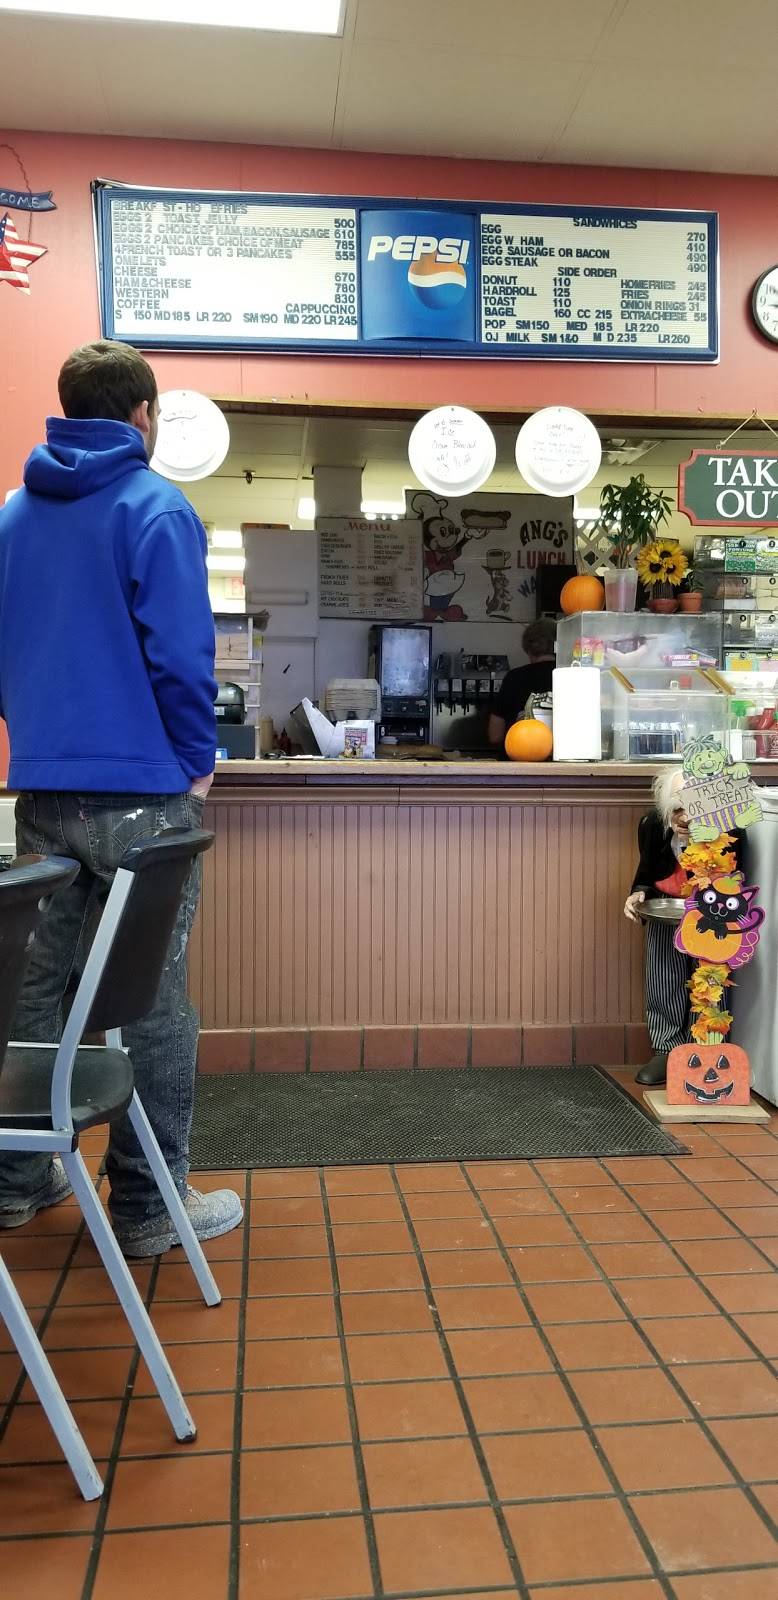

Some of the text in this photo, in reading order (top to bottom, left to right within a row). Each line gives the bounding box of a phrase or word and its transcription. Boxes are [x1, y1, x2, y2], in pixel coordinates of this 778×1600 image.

[113, 212, 142, 222] EGGS
[144, 213, 152, 222] 2
[204, 214, 238, 225] JELLY
[334, 218, 354, 228] 500
[113, 223, 143, 233] EGGS
[144, 224, 152, 233] 2
[482, 224, 502, 234] EGG
[334, 230, 354, 239] 610
[687, 232, 706, 242] 270
[113, 234, 142, 244] EGGS
[144, 235, 151, 244] 2
[154, 236, 214, 246] PANCAKES
[217, 237, 258, 248] CHOICE
[335, 240, 354, 250] 785
[482, 235, 544, 246] EGG W HAM
[167, 246, 202, 256] TOAST
[207, 247, 222, 257] OR
[226, 248, 234, 258] 3
[237, 248, 292, 259] PANCAKES
[368, 236, 470, 264] PEPSI
[482, 246, 610, 258] EGG SAUSAGE OR BACON
[686, 242, 705, 252] 410
[335, 251, 356, 260] 555
[686, 253, 706, 262] 490
[482, 256, 538, 267] EGG STEAK
[114, 266, 158, 276] CHEESE
[558, 267, 618, 278] SIDE ORDER
[687, 264, 706, 272] 490
[334, 272, 355, 282] 670
[483, 276, 571, 287] DONUT 110
[335, 283, 355, 293] 780
[620, 280, 706, 291] HOMEFRIES 245
[116, 288, 169, 298] WESTERN
[553, 288, 570, 298] 125
[622, 290, 706, 302] FRIES 245
[117, 298, 160, 310] COFFEE
[334, 294, 355, 304] 830
[483, 296, 571, 308] TOAST 110
[286, 304, 356, 314] CAPPUCCINO
[620, 300, 700, 312] ONION RINGS 31
[116, 310, 122, 320] S
[134, 311, 152, 320] 150
[212, 312, 232, 322] 220
[484, 307, 612, 320] BAGEL 160 CC 215
[484, 320, 506, 329] POP
[566, 321, 588, 331] MED
[594, 322, 612, 332] 185
[486, 332, 498, 342] OJ
[506, 332, 530, 342] MILK
[520, 520, 568, 548] ANG'S
[517, 550, 566, 570] LUNCH
[696, 777, 734, 798] TRICK
[688, 786, 750, 816] OR TREAT
